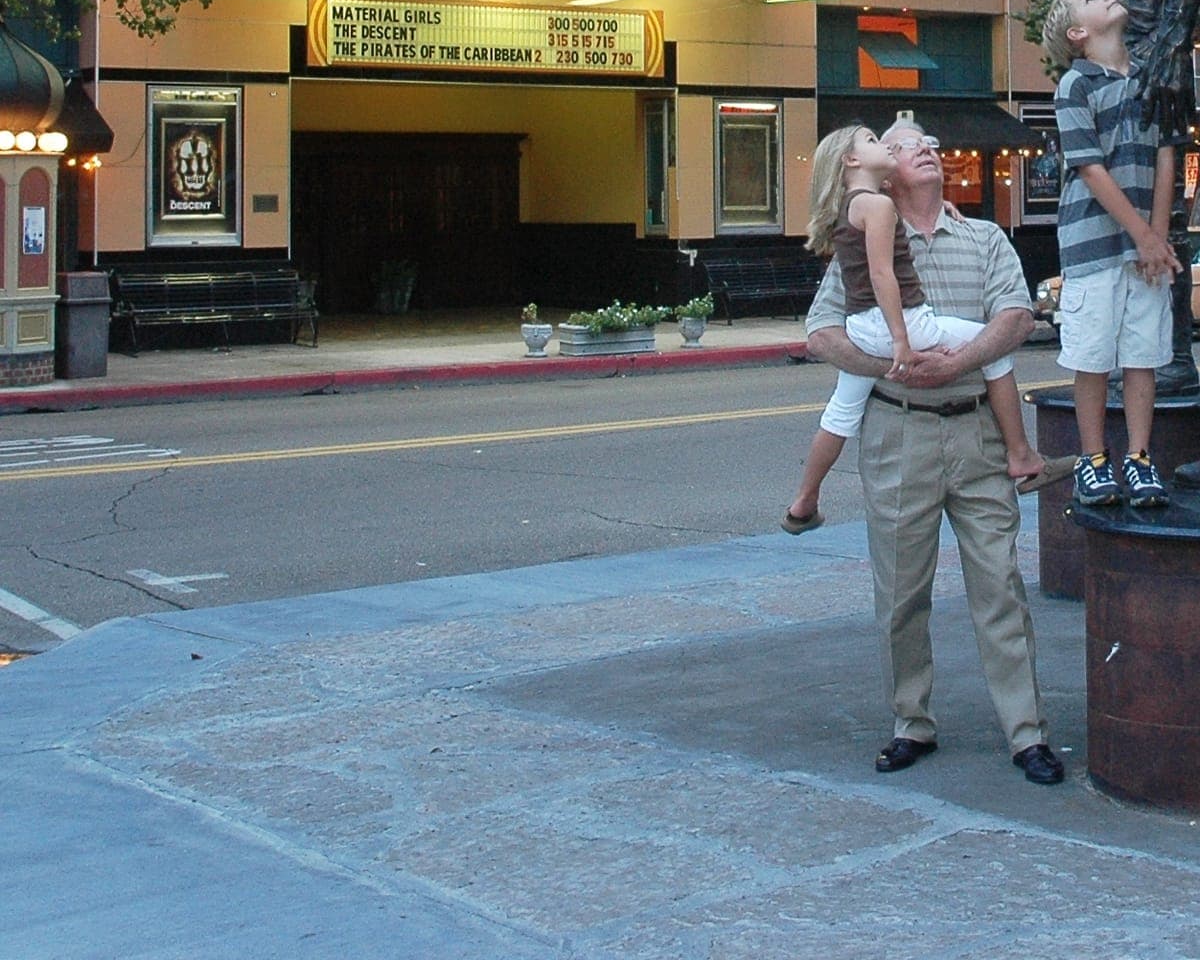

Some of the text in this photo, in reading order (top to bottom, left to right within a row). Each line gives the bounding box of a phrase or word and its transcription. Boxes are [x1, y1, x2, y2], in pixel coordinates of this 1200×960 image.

[332, 6, 618, 33] MATERIAL GIRLS 300 500 700
[334, 24, 357, 38] THE
[362, 25, 417, 40] DESCENT
[334, 42, 633, 66] THE PIRATES OF THE CARIBBEAN 2 230 500 730
[170, 200, 211, 210] DESCENT
